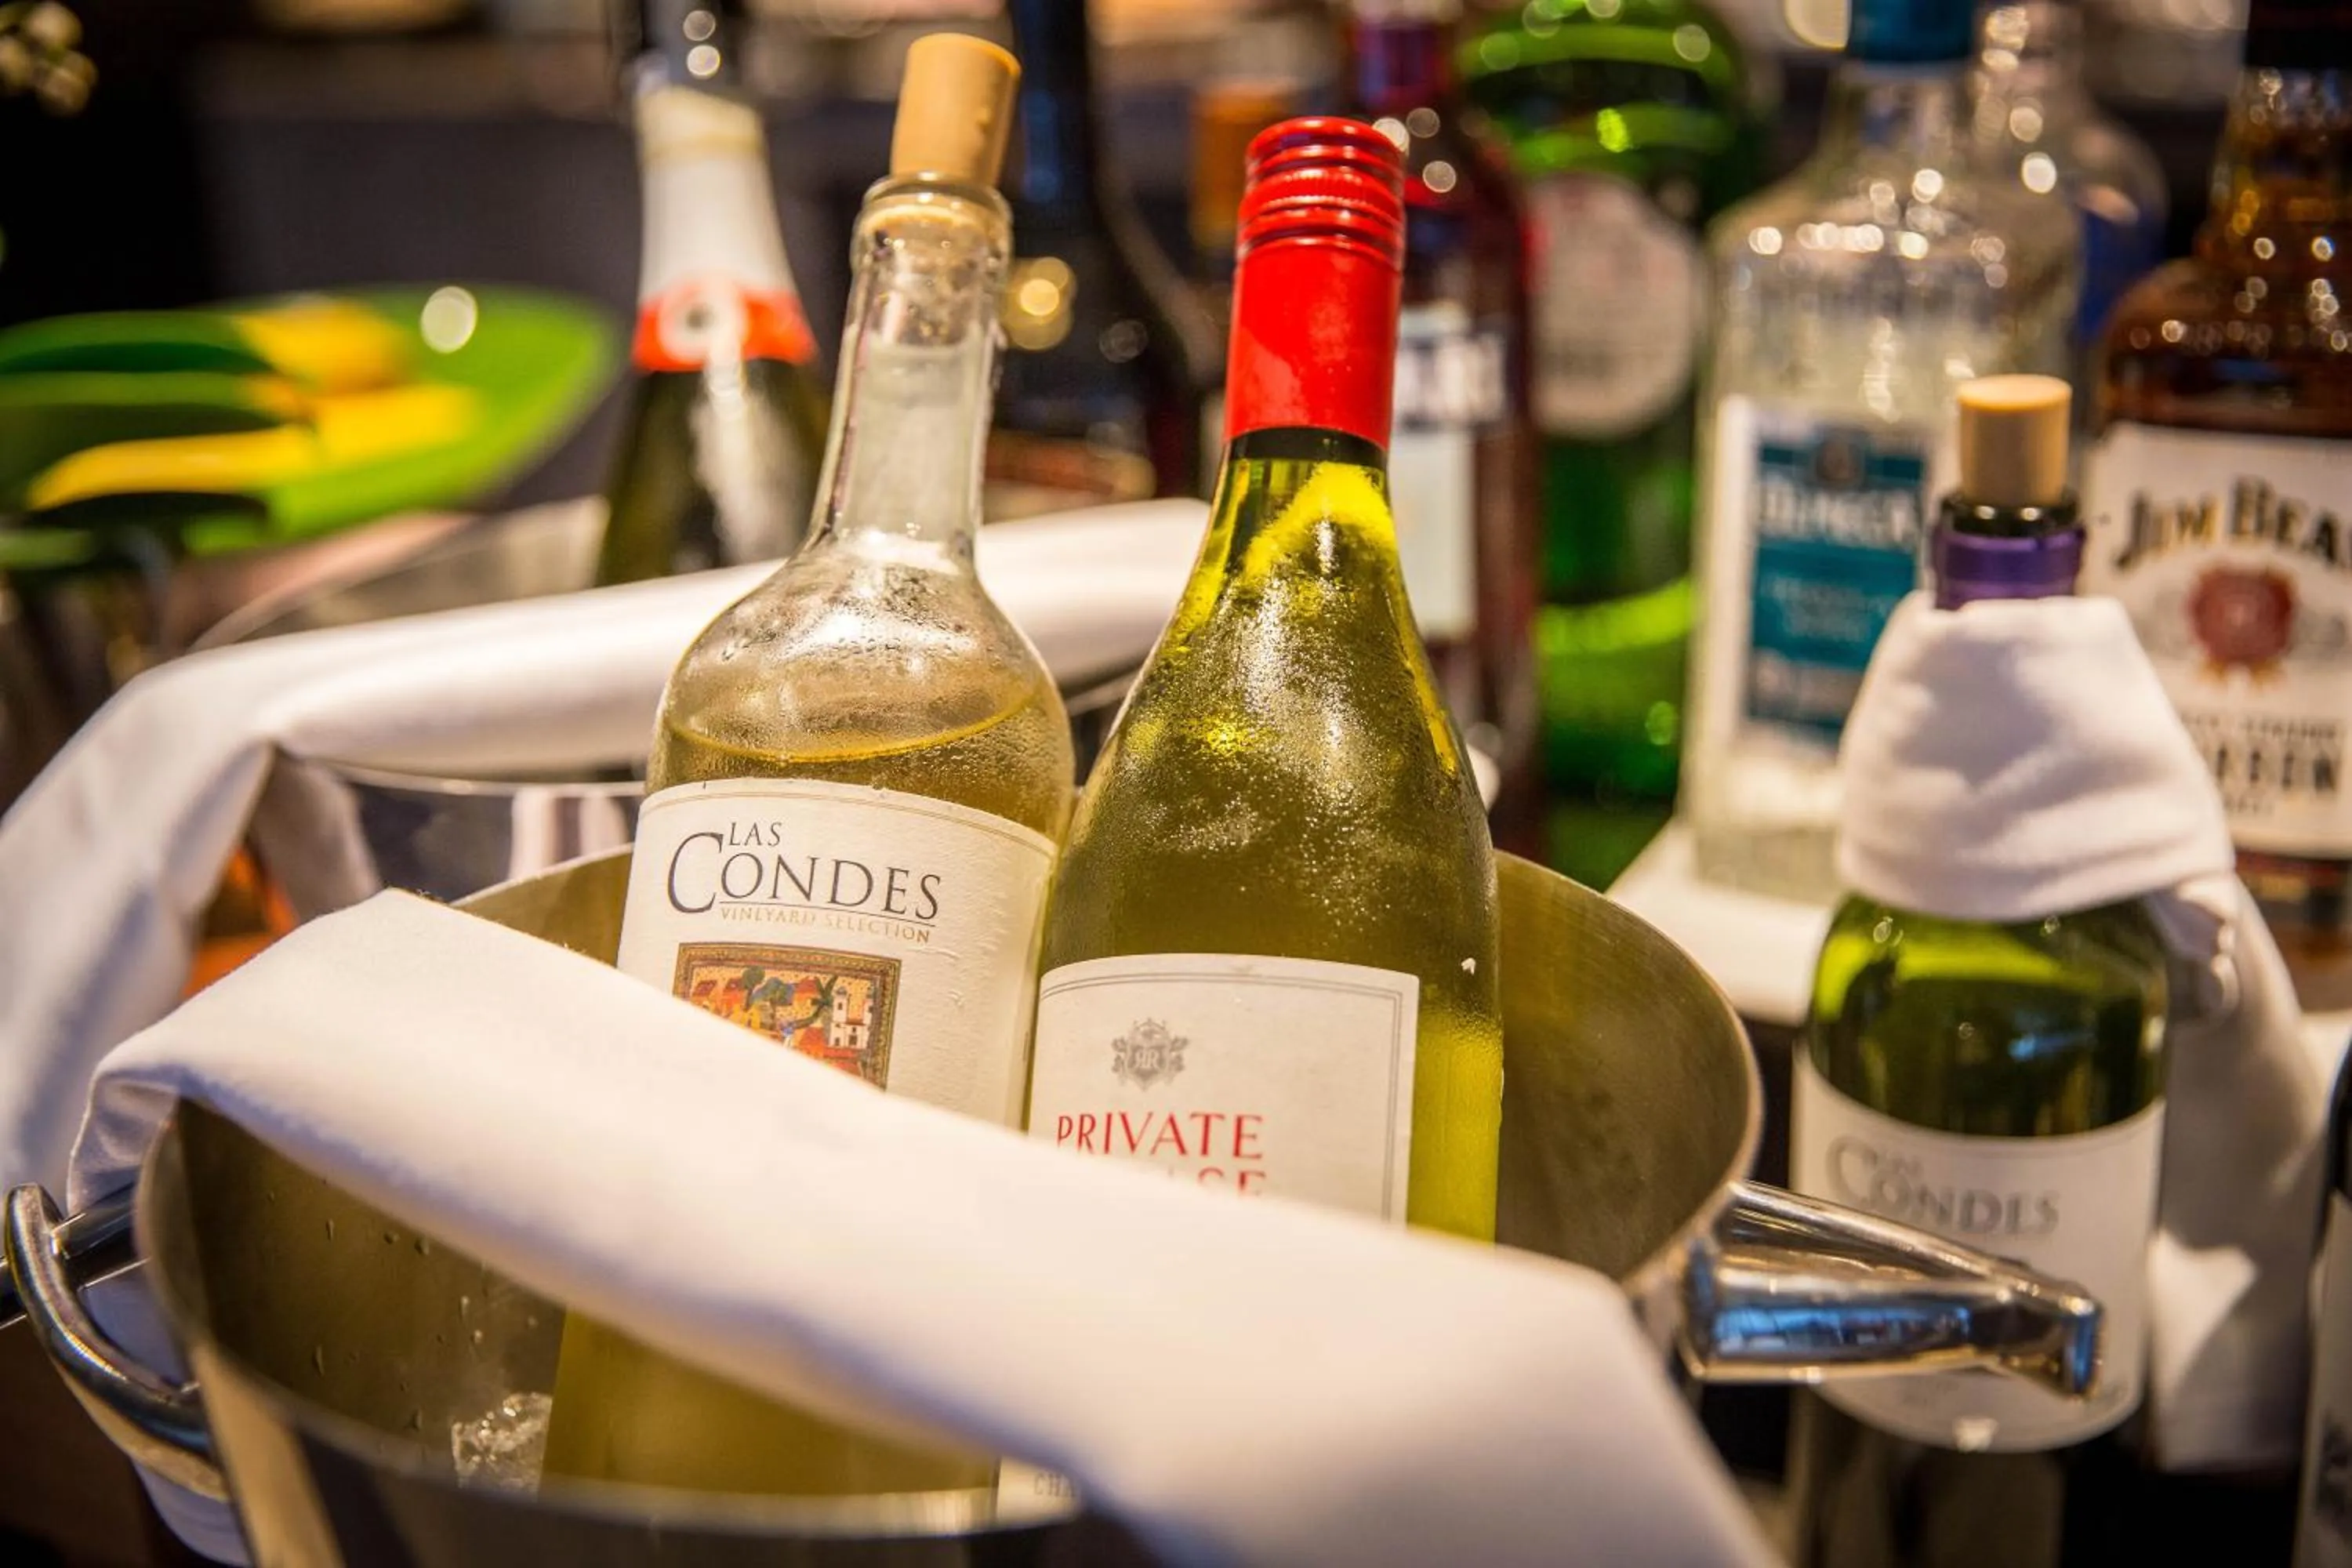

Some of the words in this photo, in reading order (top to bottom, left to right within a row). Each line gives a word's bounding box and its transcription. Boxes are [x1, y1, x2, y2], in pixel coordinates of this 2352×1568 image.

[2230, 474, 2352, 568] BEA
[728, 822, 782, 847] LAS
[667, 832, 942, 920] CONDES
[720, 906, 815, 925] VINEYARD
[825, 913, 930, 943] SELECTION
[1058, 1111, 1263, 1160] PRIVATE
